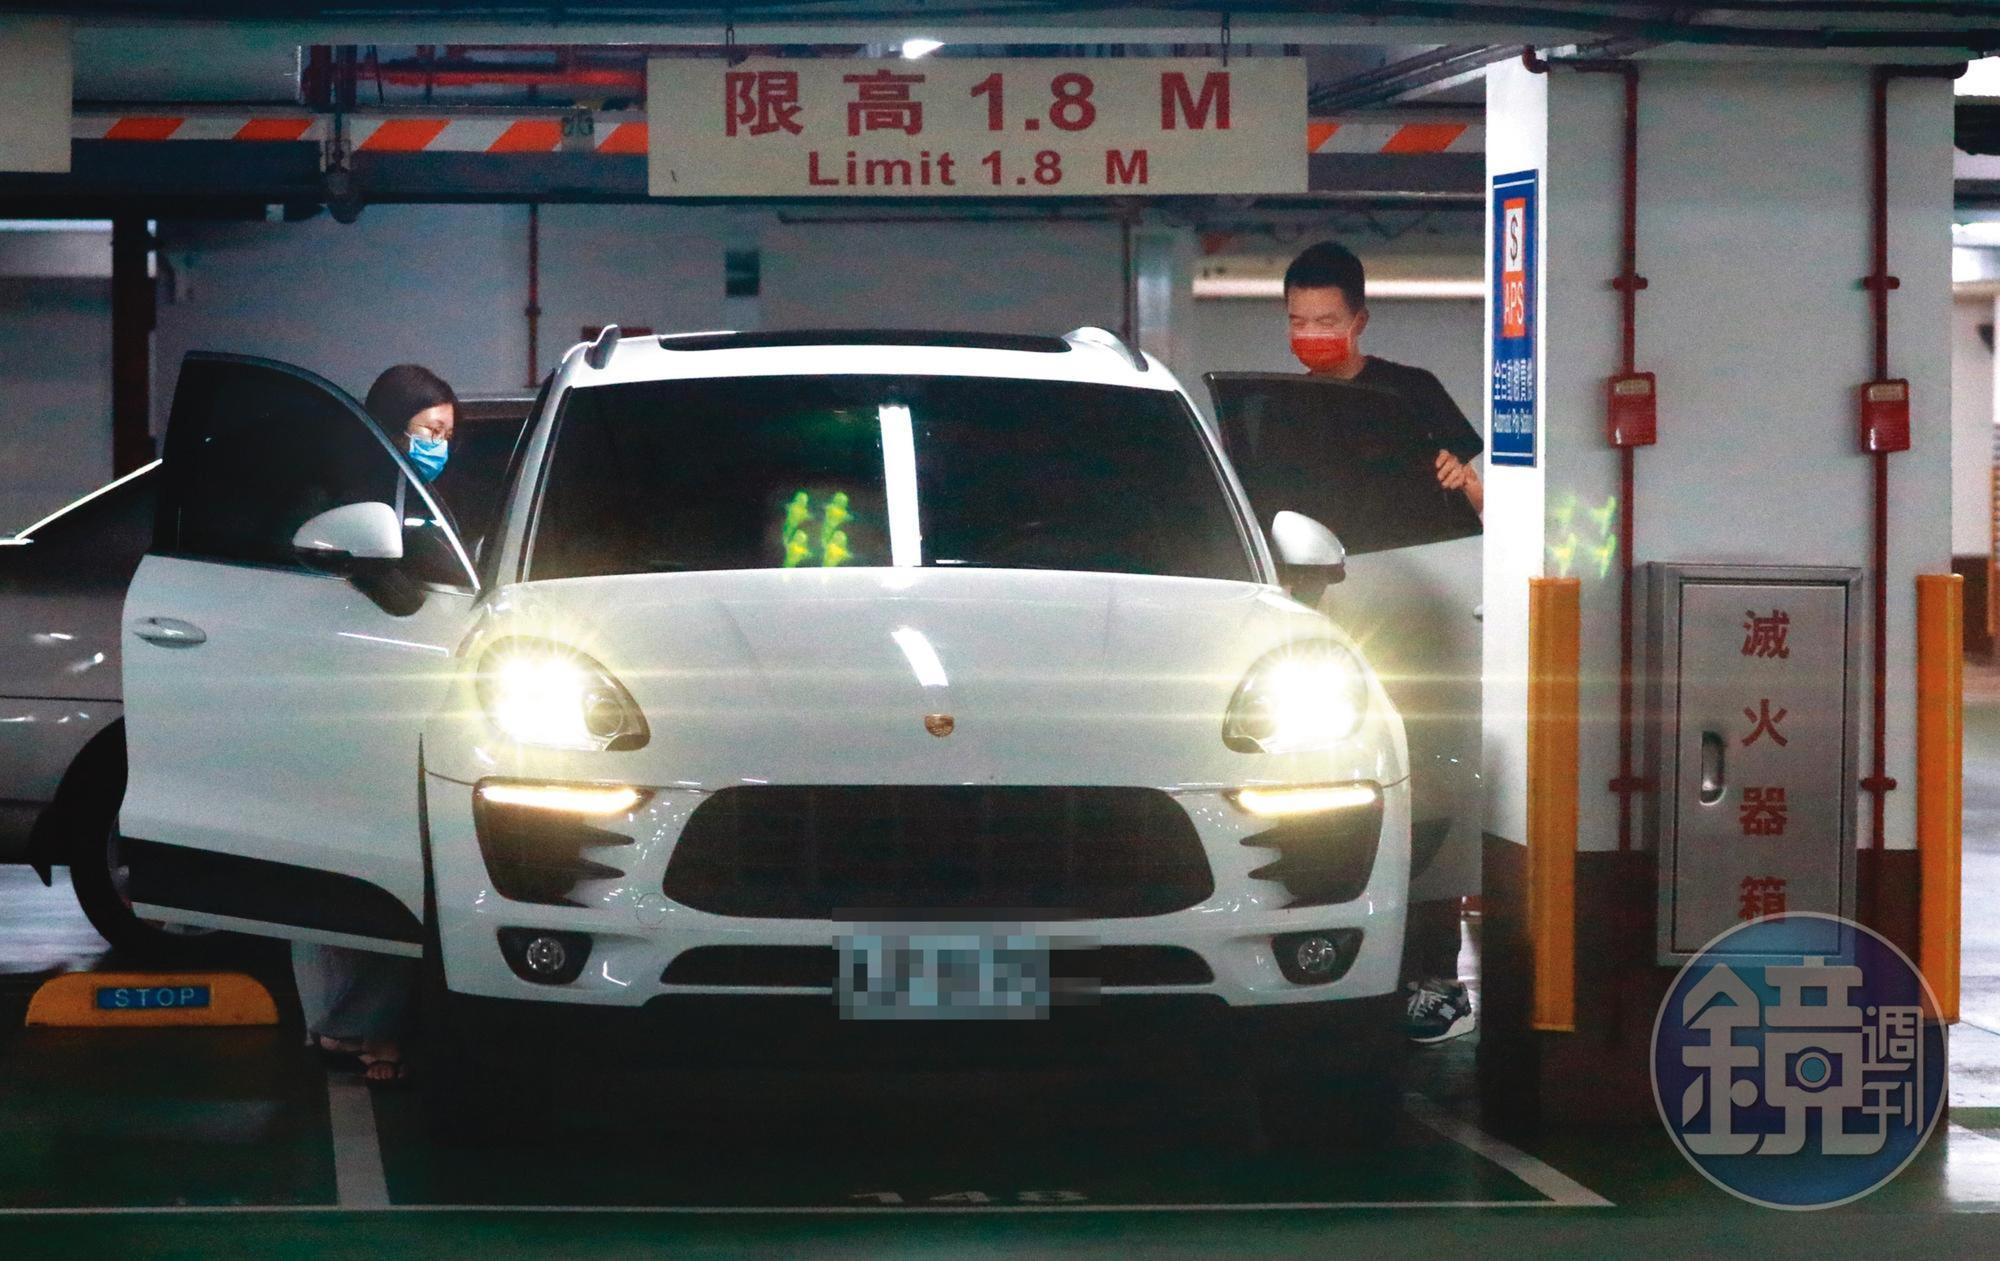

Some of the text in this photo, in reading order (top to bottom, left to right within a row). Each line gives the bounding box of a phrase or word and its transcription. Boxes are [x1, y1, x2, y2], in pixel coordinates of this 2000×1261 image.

[724, 69, 1232, 137] 限高 1.8 M
[808, 150, 1149, 186] Limit 1.8 M
[1504, 281, 1524, 326] APS
[1738, 609, 1790, 924] 滅火器箱
[114, 987, 195, 1008] STOP
